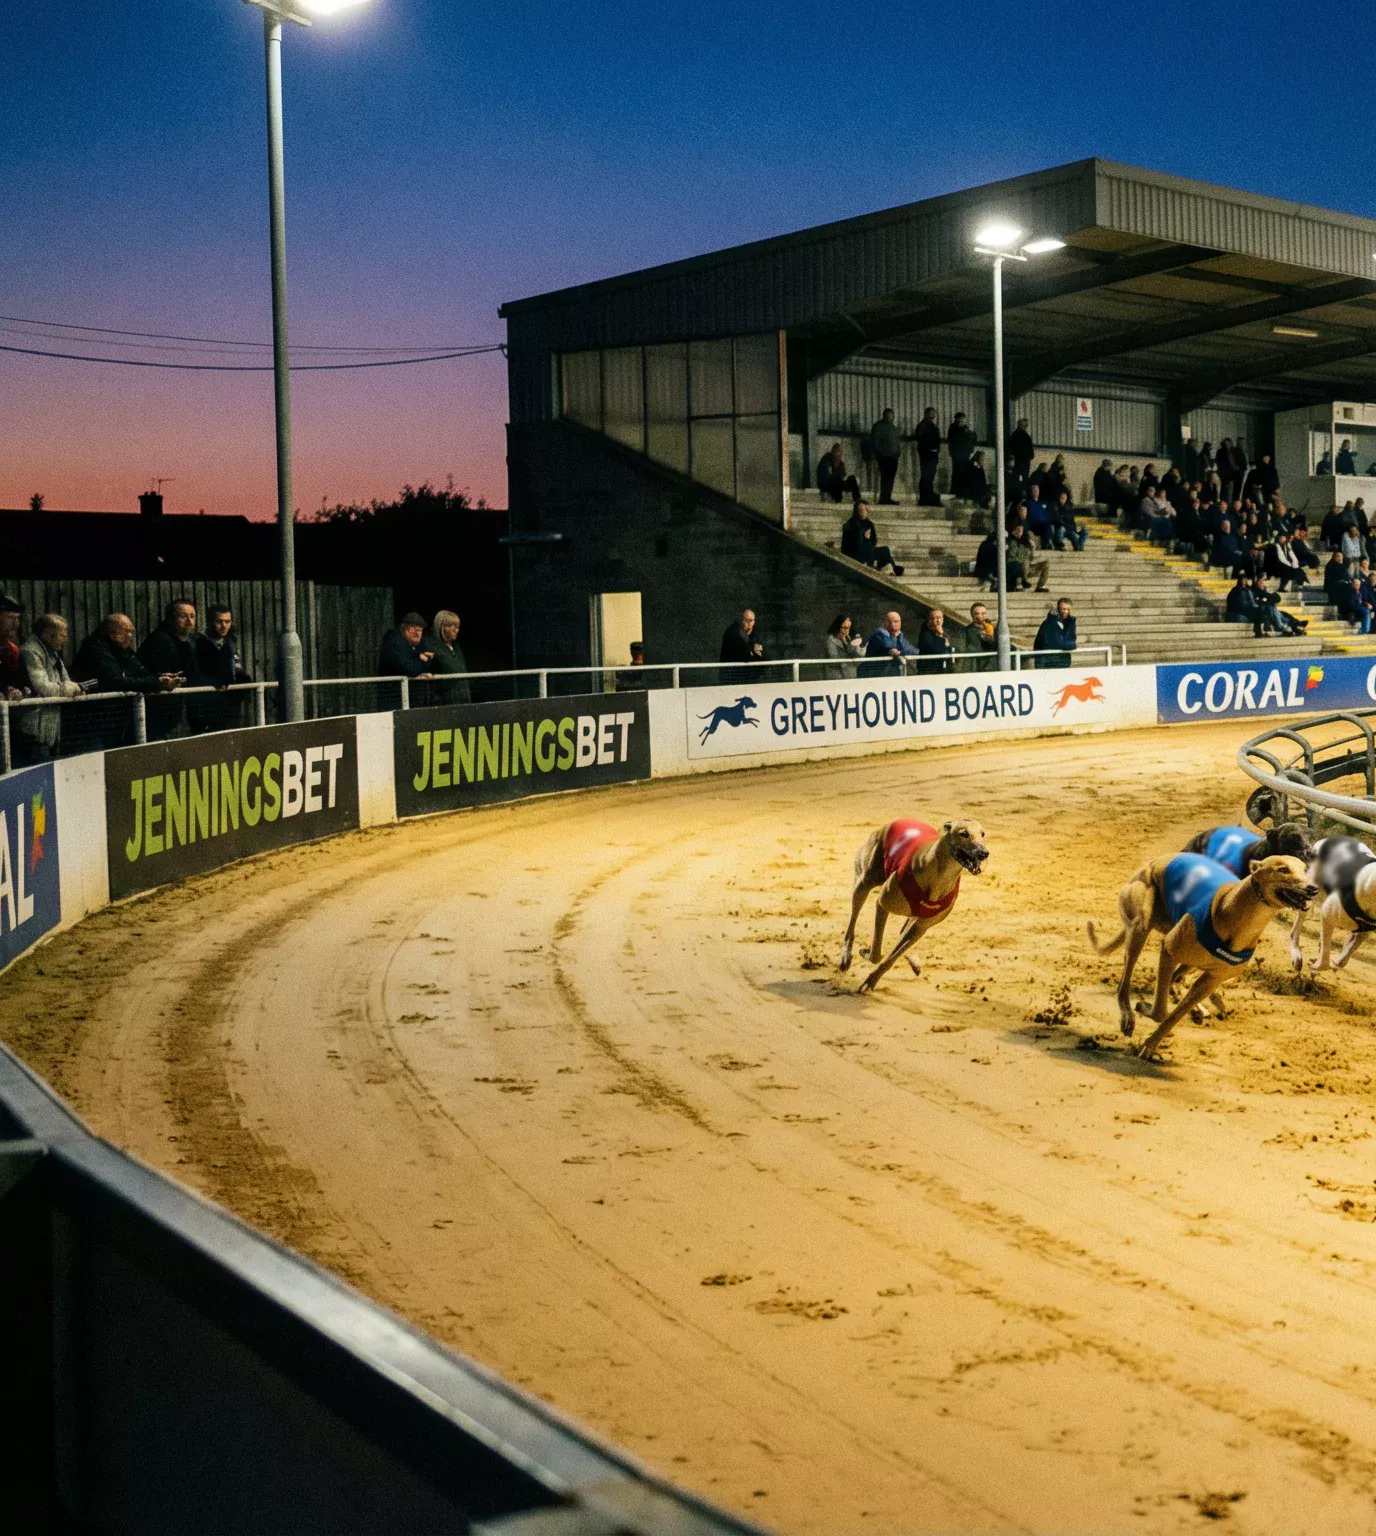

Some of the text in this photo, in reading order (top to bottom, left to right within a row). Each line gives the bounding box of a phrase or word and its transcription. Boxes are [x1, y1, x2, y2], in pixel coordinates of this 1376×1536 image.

[770, 683, 1034, 736] GREYHOUND BOARD
[1177, 668, 1305, 714] CORAL
[413, 713, 635, 791] JENNINGSBET
[125, 743, 344, 862] JENNINGSBET
